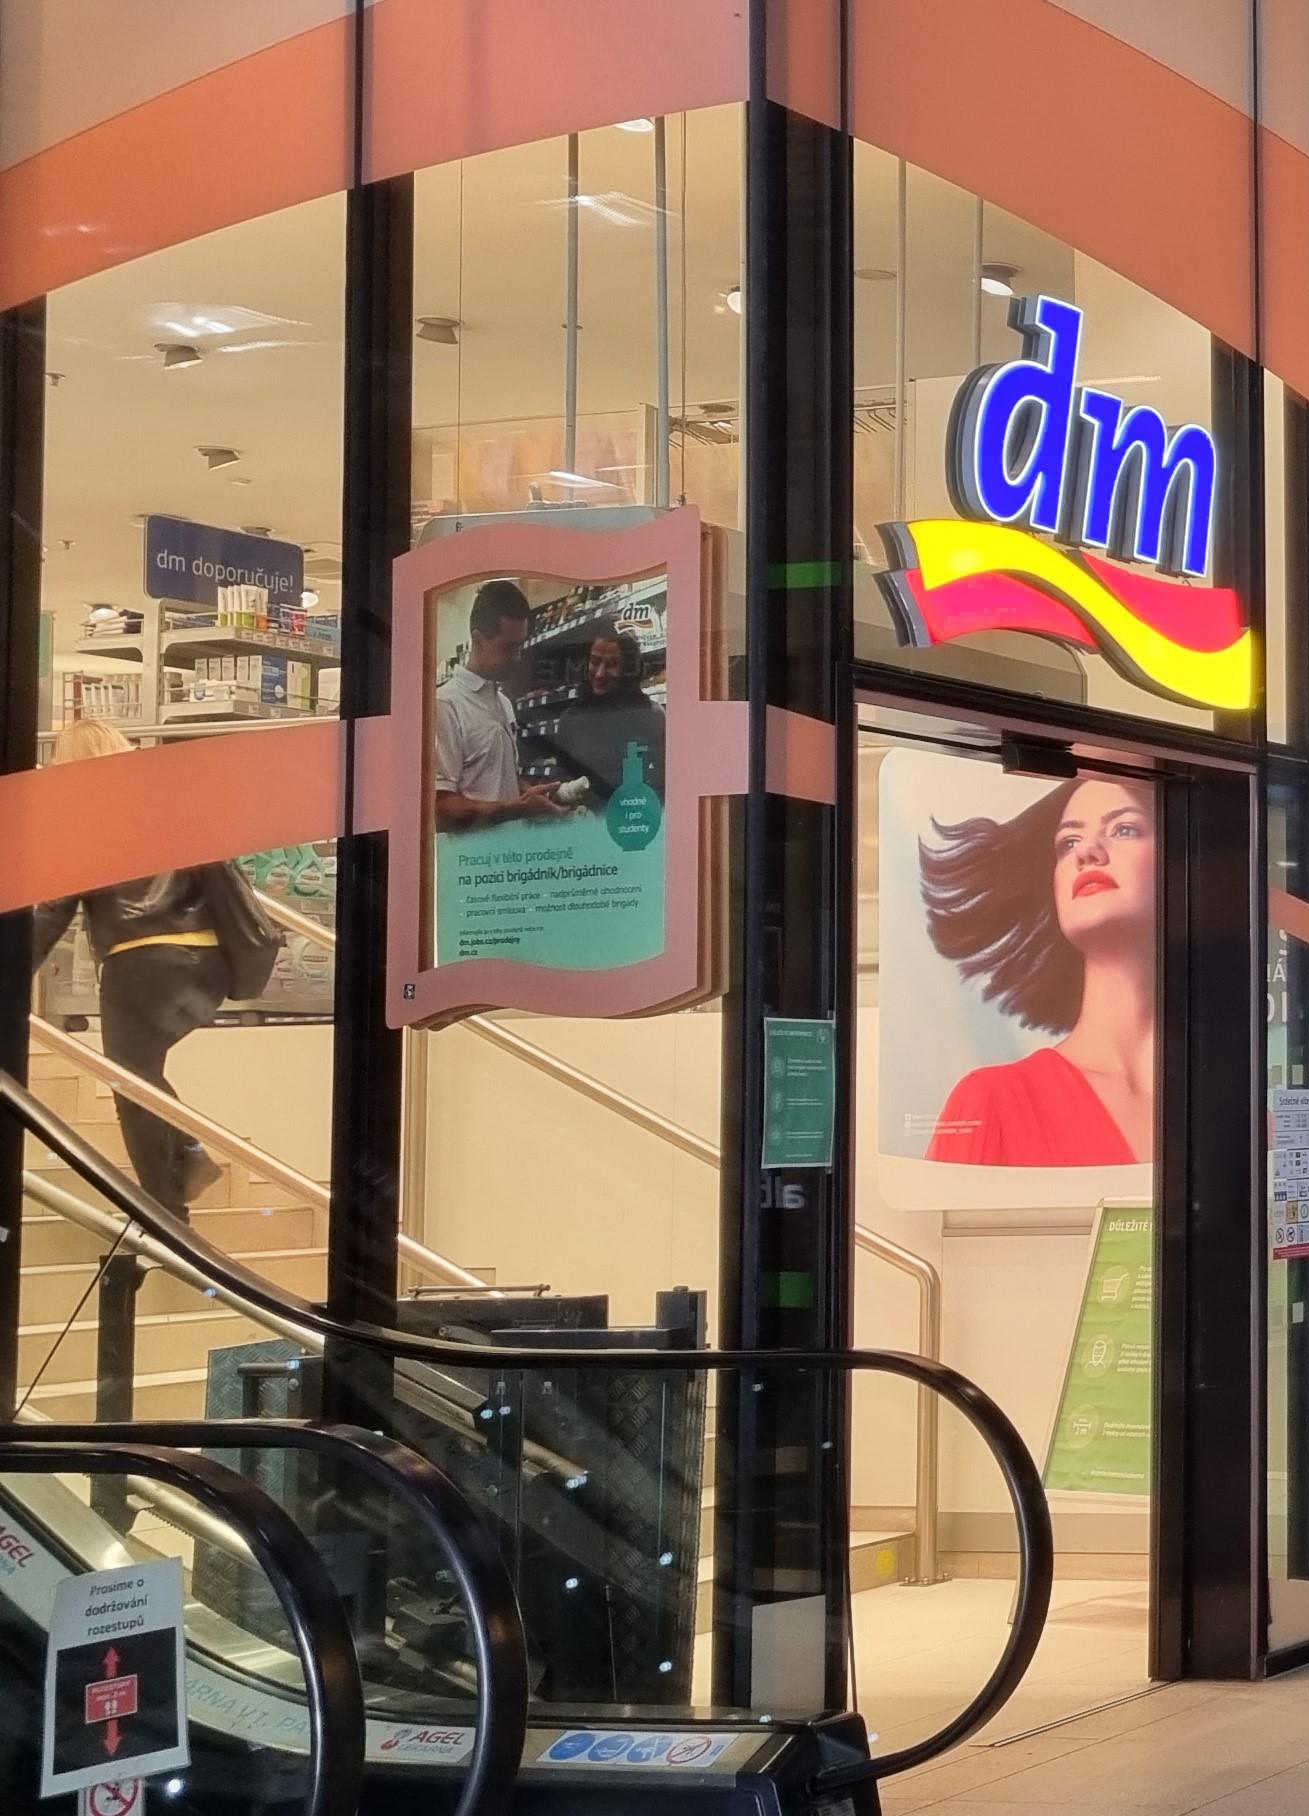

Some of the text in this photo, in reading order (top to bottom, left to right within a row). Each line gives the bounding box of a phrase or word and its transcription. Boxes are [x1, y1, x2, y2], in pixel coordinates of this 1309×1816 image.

[974, 294, 1216, 577] dm
[156, 549, 294, 594] dm doporučuje!
[623, 602, 649, 620] dm
[458, 852, 492, 868] Pracuj
[502, 851, 522, 863] této
[525, 847, 573, 865] prodejně
[458, 875, 471, 885] na
[507, 864, 618, 885] brigádník/brigádnice
[1109, 1219, 1149, 1232] DŮLEŽITÉ
[89, 1578, 144, 1597] Prosíme o
[85, 1596, 148, 1618] dodržování
[87, 1616, 144, 1637] rozestupů
[411, 1729, 466, 1746] AGEL
